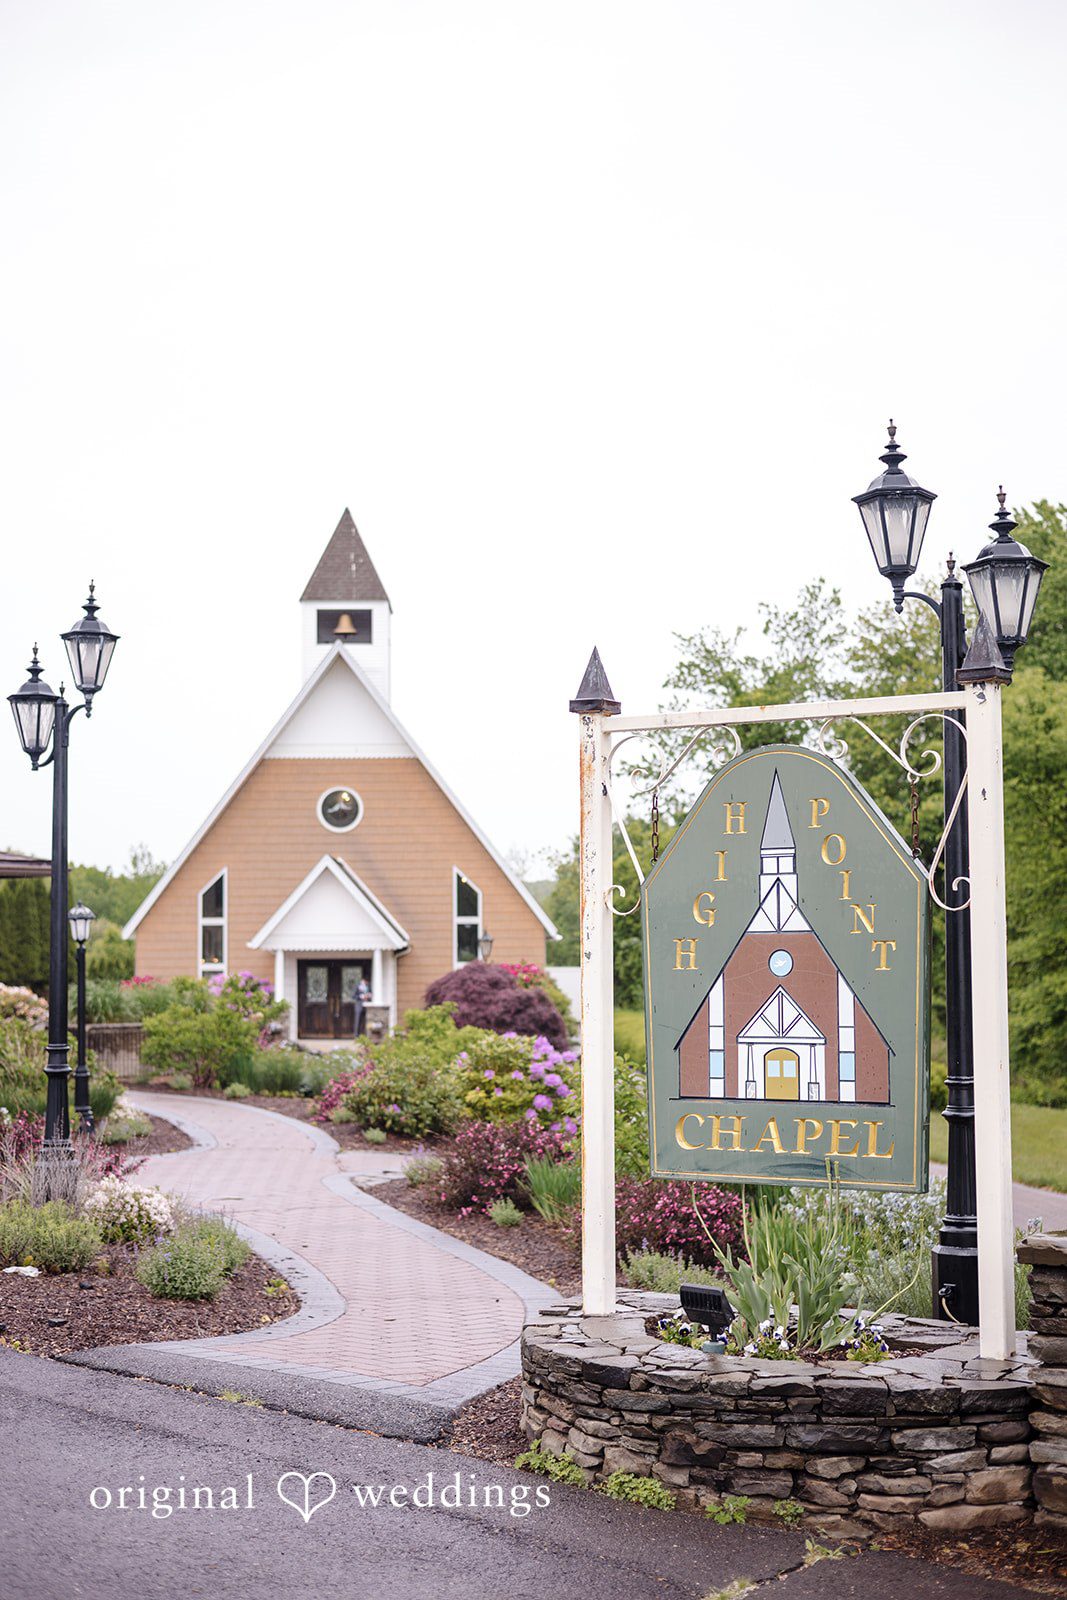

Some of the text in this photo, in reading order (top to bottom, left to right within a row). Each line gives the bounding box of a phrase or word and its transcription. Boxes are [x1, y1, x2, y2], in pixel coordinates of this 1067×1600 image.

[672, 797, 896, 971] HIGH POINT
[674, 1112, 895, 1159] CHAPEL
